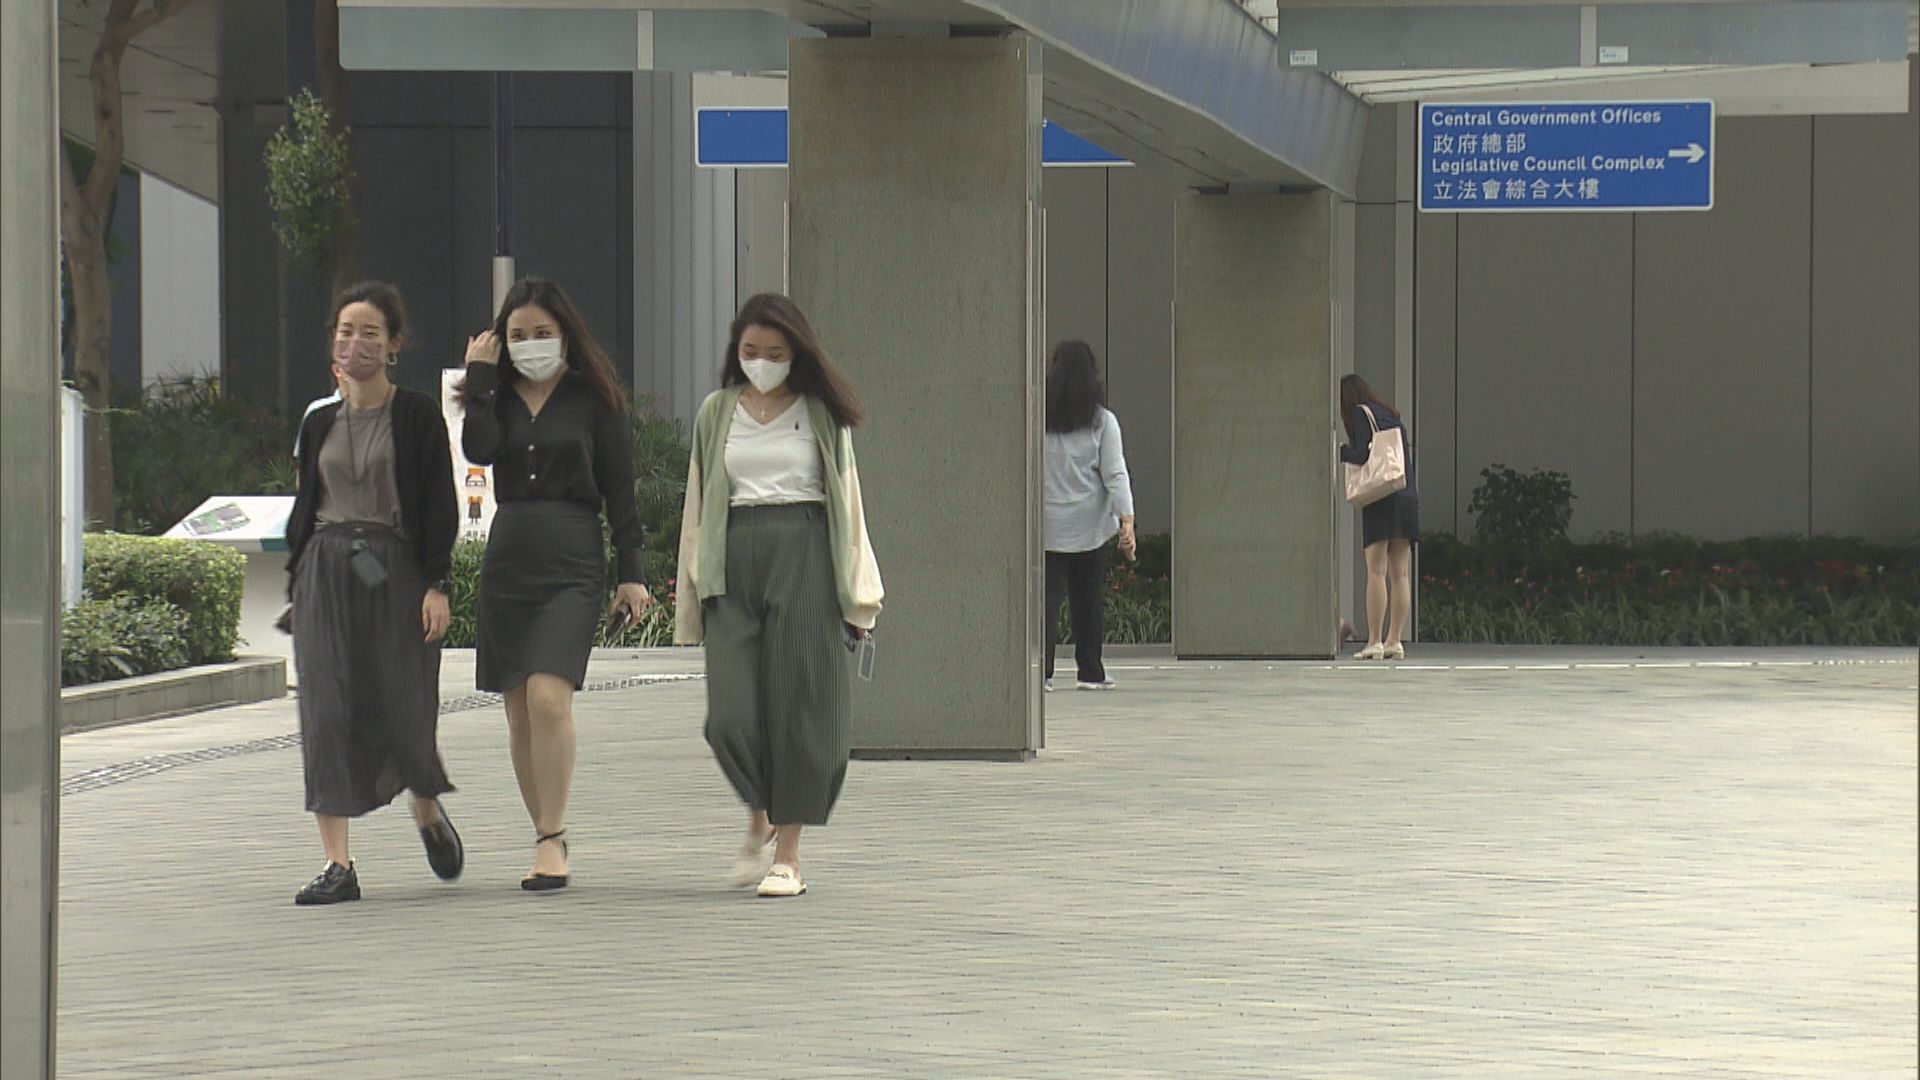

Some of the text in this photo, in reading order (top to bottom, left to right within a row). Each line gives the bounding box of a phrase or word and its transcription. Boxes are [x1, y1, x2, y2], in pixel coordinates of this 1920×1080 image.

[1431, 108, 1662, 126] Central Government Offices
[1433, 132, 1526, 154] 政府總部
[1432, 155, 1666, 176] Legislative Council Complex
[1433, 178, 1600, 200] 立法會綜合大樓
